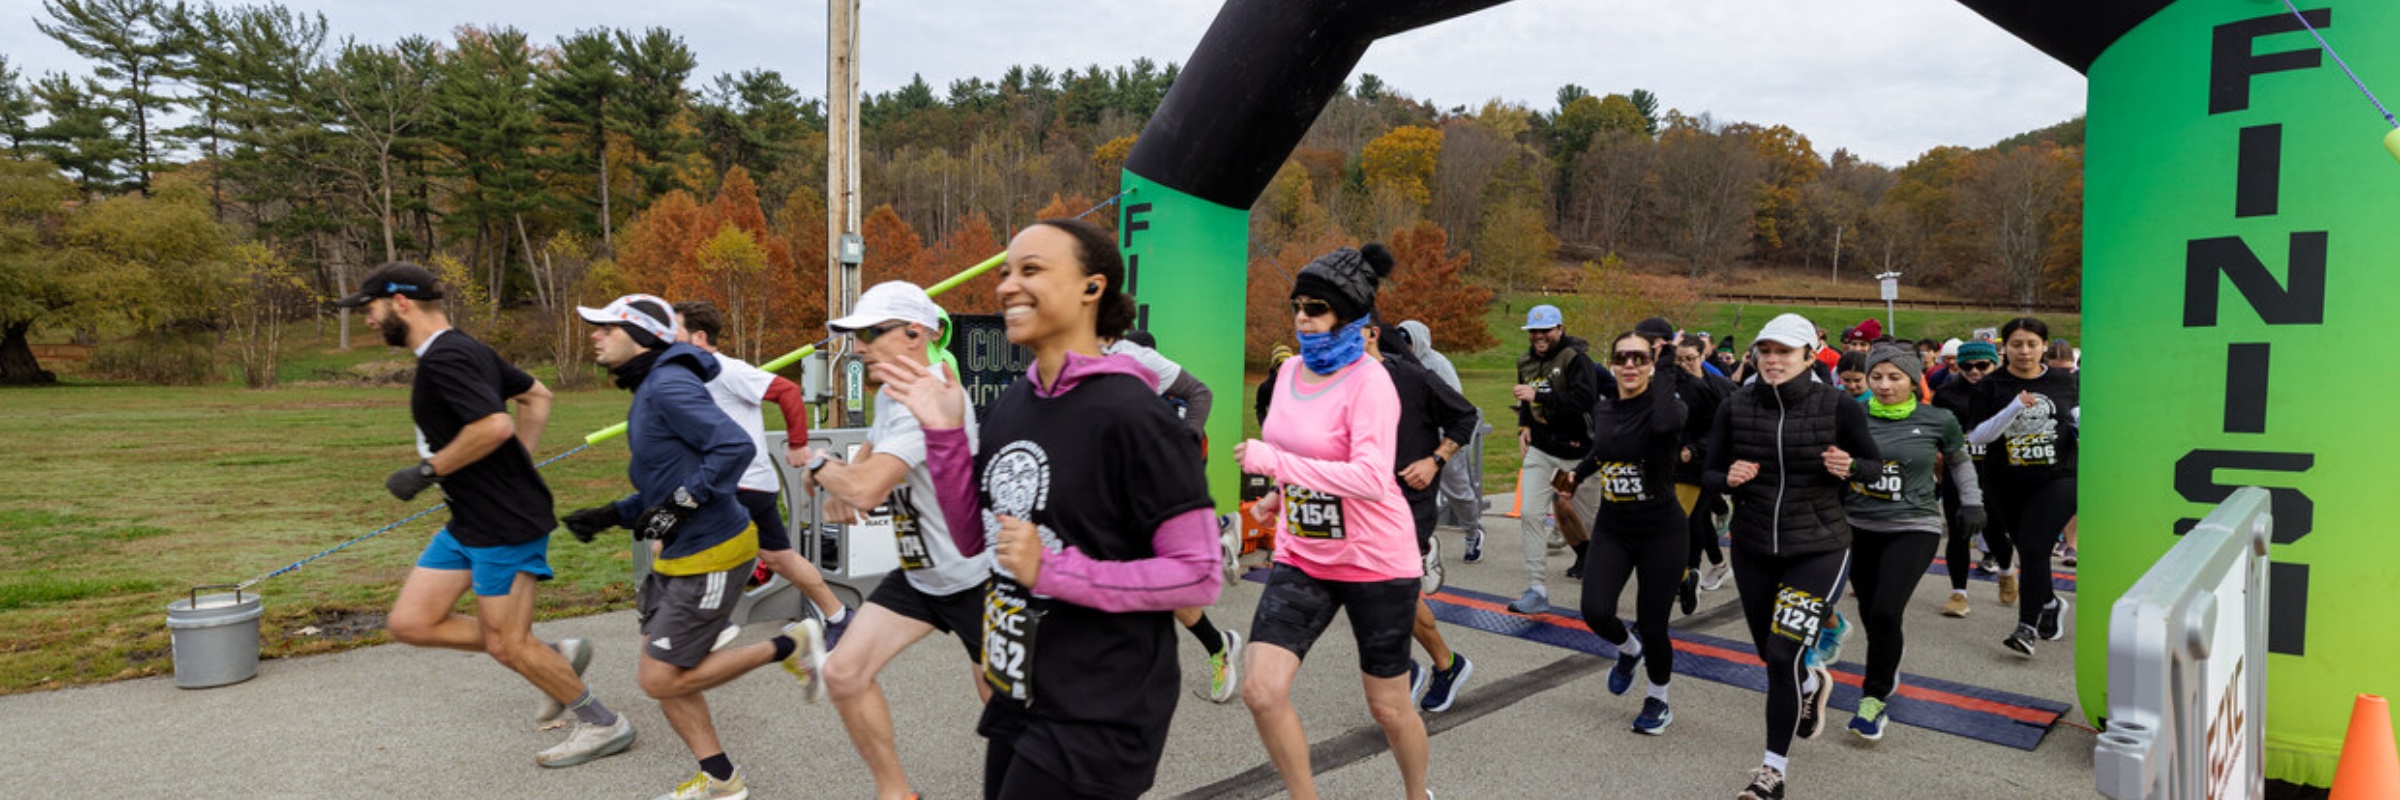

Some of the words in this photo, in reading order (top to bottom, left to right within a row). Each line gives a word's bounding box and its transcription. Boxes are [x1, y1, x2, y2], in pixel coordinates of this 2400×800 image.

[2010, 445, 2056, 459] 2206
[1603, 478, 1643, 494] 2123
[1287, 501, 1341, 527] 2154
[1772, 601, 1821, 636] 2124
